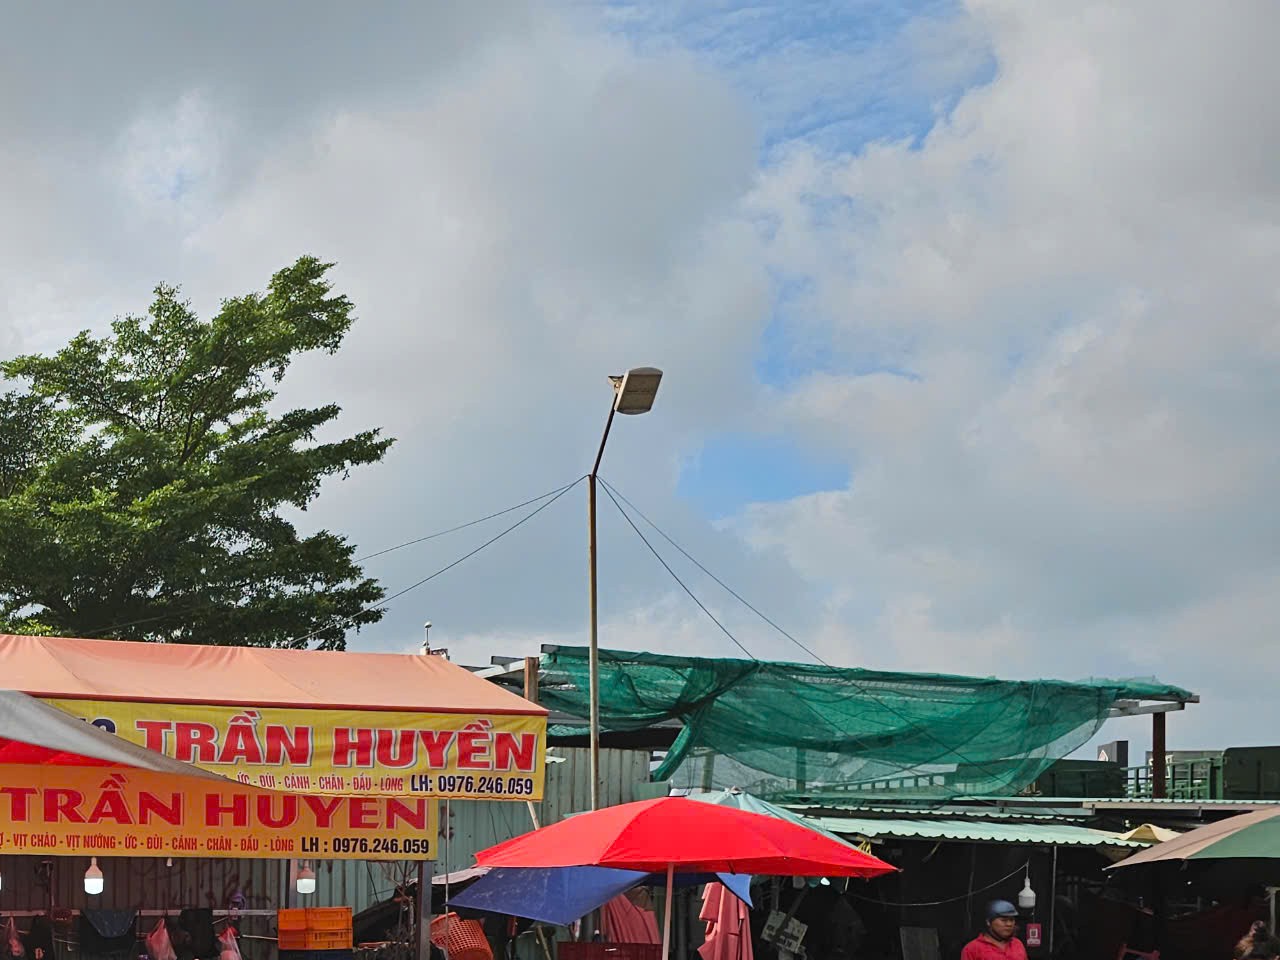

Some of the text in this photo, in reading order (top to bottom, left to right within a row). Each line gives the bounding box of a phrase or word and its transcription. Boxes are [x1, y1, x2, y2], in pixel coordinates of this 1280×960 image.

[136, 710, 537, 772] TRẦN HUYỀN
[0, 773, 184, 826] TRẦN
[284, 773, 310, 789] CÁNH
[380, 775, 404, 792] LÒNG
[438, 775, 534, 795] 0976.246.059
[13, 833, 28, 850] VỊT
[65, 834, 80, 851] VỊT
[83, 833, 116, 849] NƯỚNG
[172, 834, 197, 851] CÁNH
[270, 837, 294, 851] LÒNG
[332, 837, 430, 854] 0976.246.059
